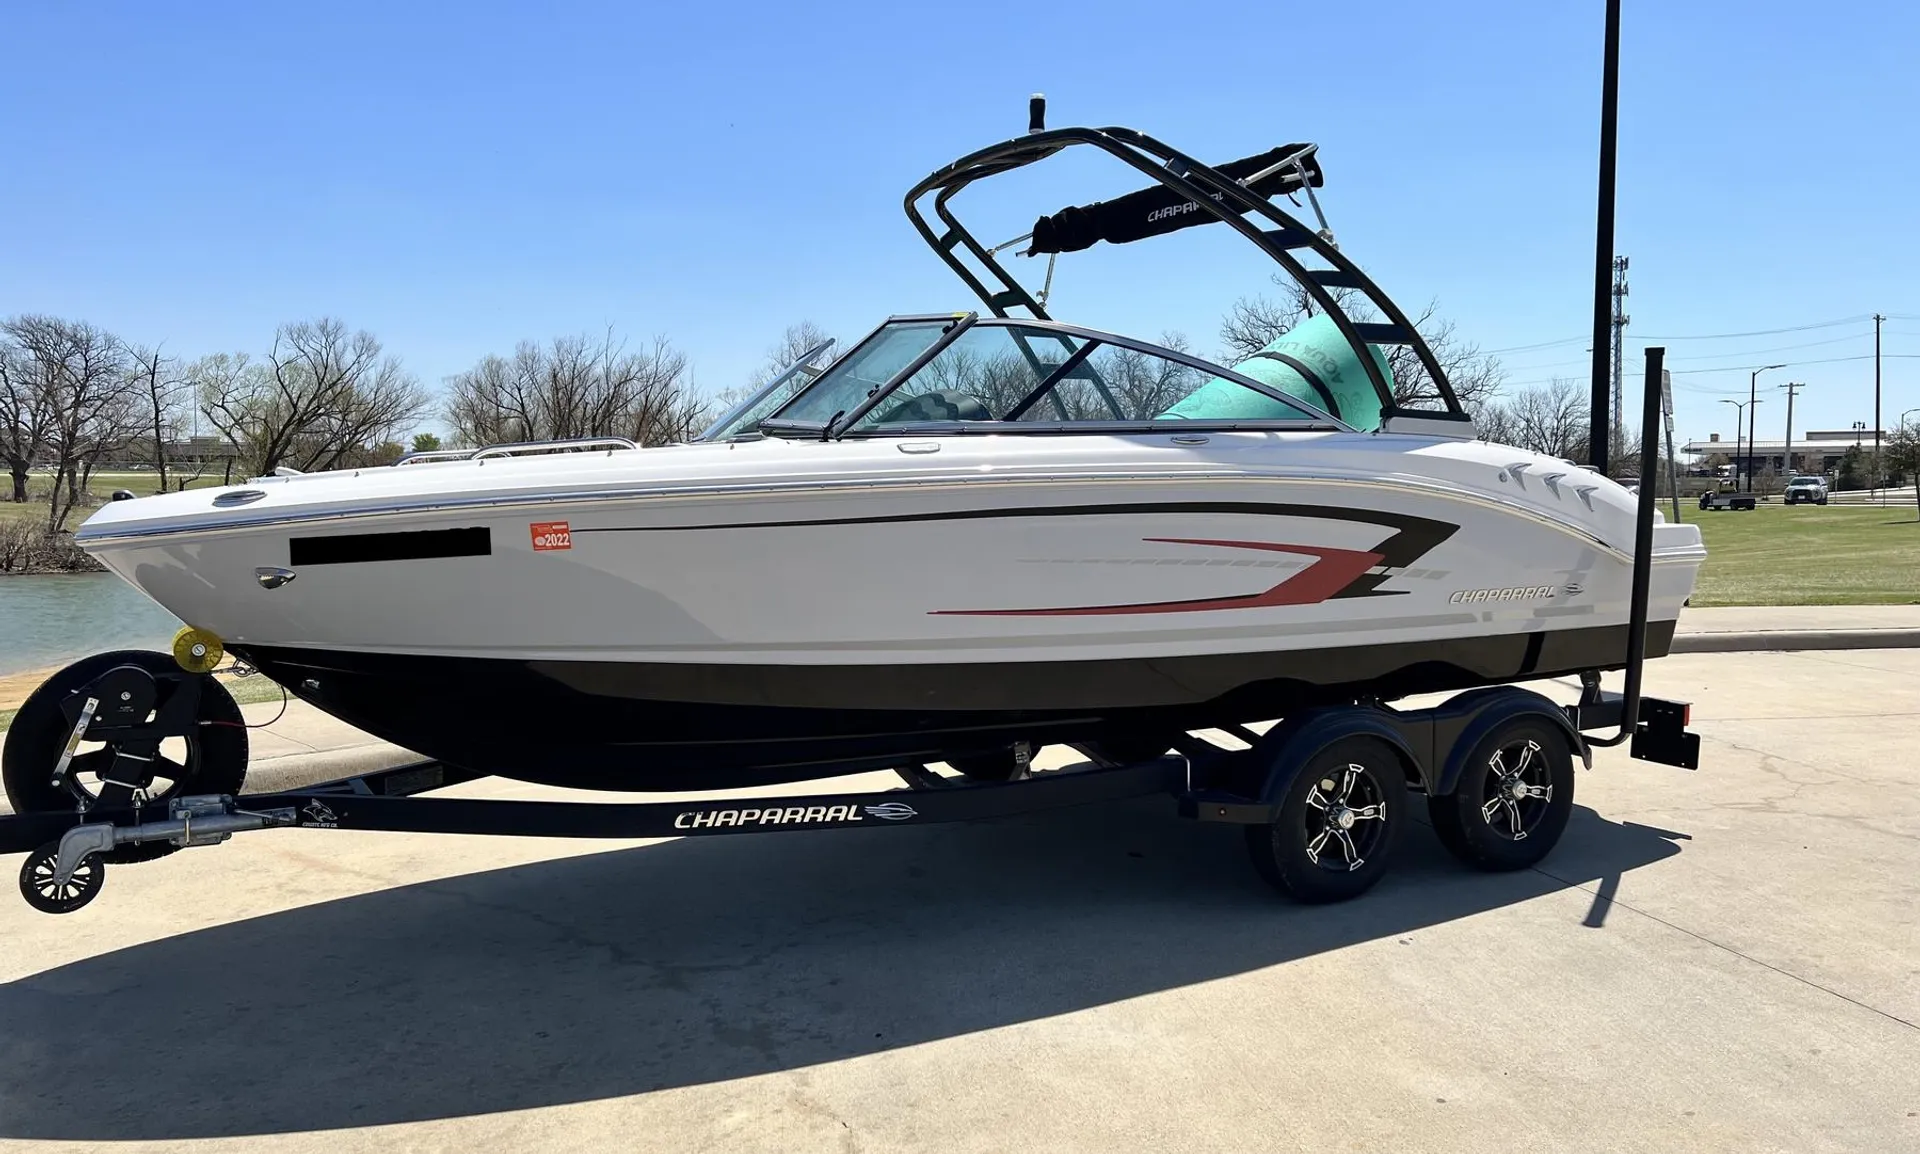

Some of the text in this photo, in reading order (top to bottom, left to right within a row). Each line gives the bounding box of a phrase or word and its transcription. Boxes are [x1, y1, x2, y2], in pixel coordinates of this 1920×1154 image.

[1147, 191, 1224, 222] CHAPAAL
[544, 533, 570, 546] 2022
[1449, 585, 1555, 604] CHAPARRAL
[674, 805, 863, 829] CHAPARRAL
